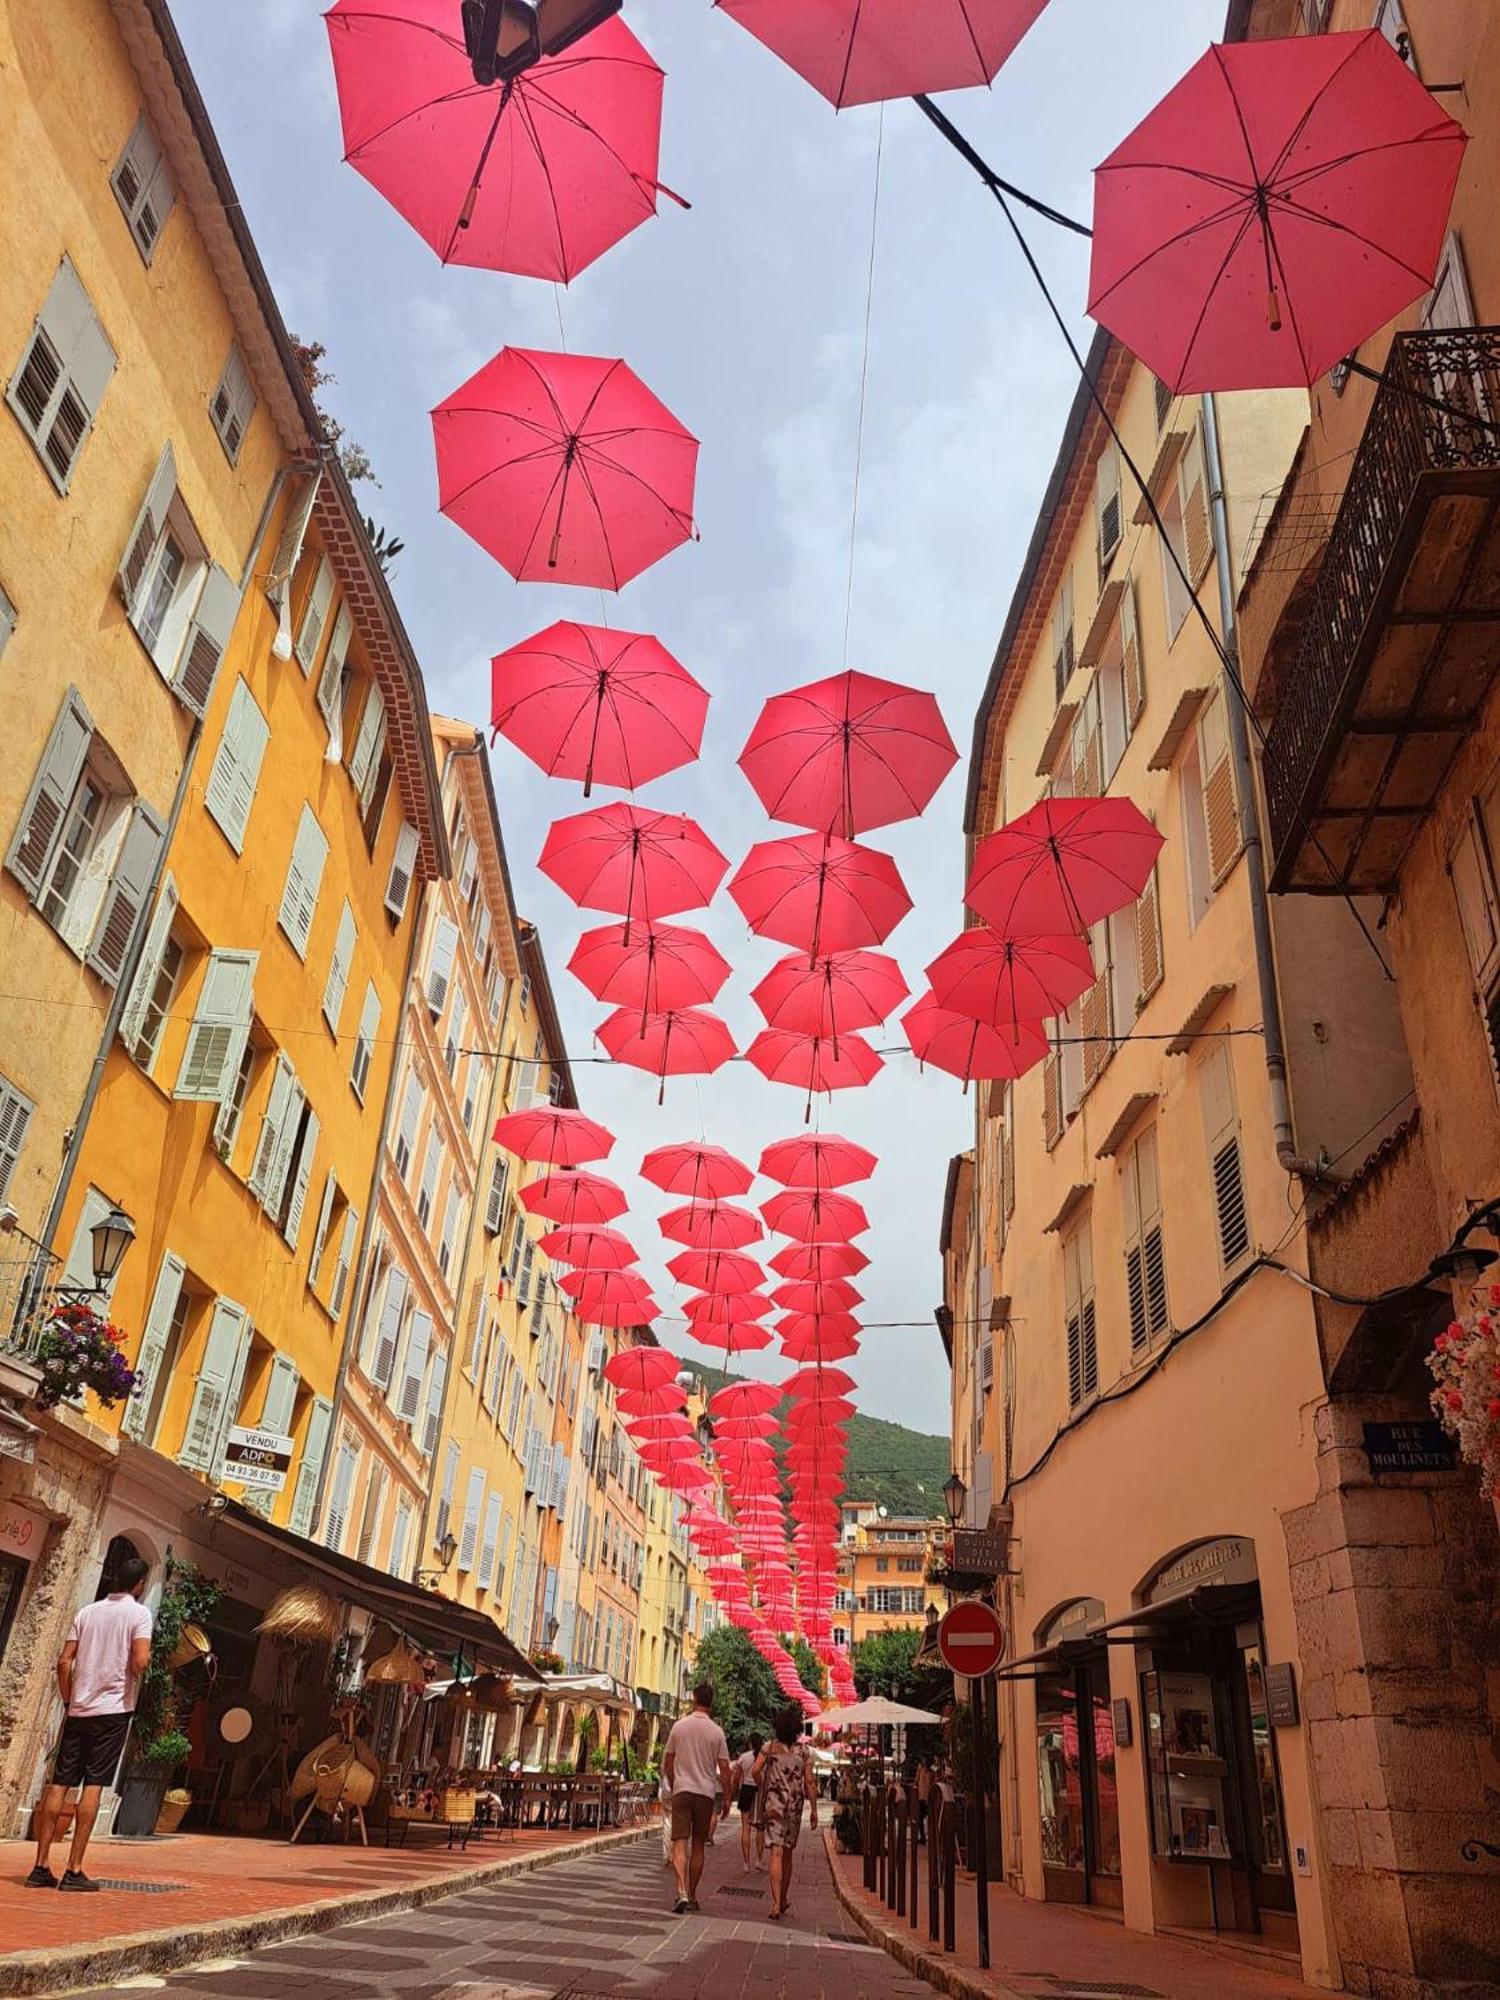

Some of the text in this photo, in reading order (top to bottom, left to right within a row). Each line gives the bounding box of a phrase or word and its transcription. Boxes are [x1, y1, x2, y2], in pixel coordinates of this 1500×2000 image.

[1391, 1427, 1424, 1439] RUE
[246, 1435, 278, 1449] VENDU
[1398, 1441, 1424, 1452] DES
[1373, 1452, 1450, 1466] MOULINETS
[963, 1538, 998, 1548] GUILDE
[972, 1549, 990, 1557] DES
